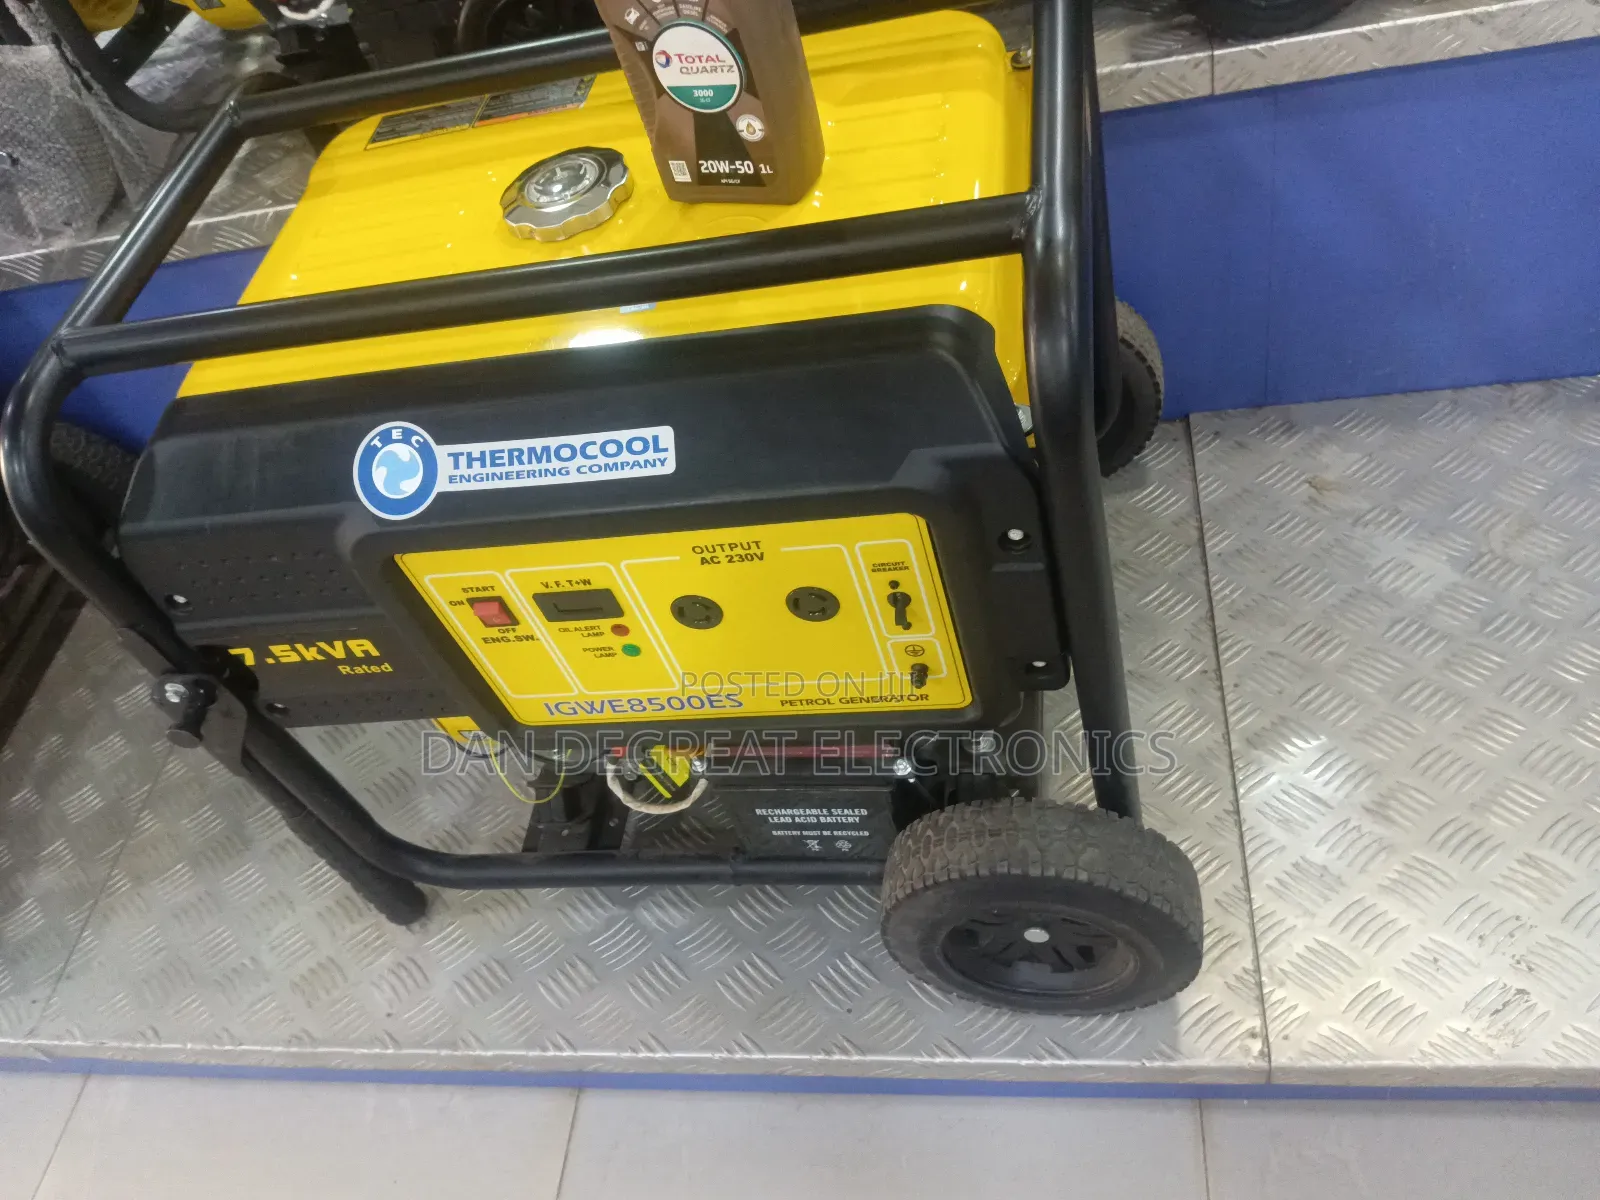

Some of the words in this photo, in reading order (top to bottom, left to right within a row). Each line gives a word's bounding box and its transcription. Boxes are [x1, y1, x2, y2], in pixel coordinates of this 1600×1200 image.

[674, 53, 726, 65] TOTAL
[679, 64, 736, 75] QUARTZ
[693, 89, 714, 97] 3000
[698, 160, 754, 174] 20W-50
[759, 163, 774, 174] 1L
[369, 428, 425, 449] TEC
[447, 433, 669, 471] THERMOCOOL
[447, 466, 571, 485] ENGINEERING
[575, 457, 669, 475] COMPANY
[691, 540, 763, 555] OUTPUT
[700, 554, 721, 565] AC
[725, 551, 765, 563] 230V
[461, 585, 496, 594] START
[228, 638, 381, 667] 7.5kVA
[337, 662, 393, 675] Rated
[543, 693, 744, 716] IGWE8500ES
[780, 697, 835, 707] PETROL
[838, 694, 930, 704] GENERATOR
[755, 808, 829, 816] RECHARGEABLE
[831, 808, 868, 816] SEALED
